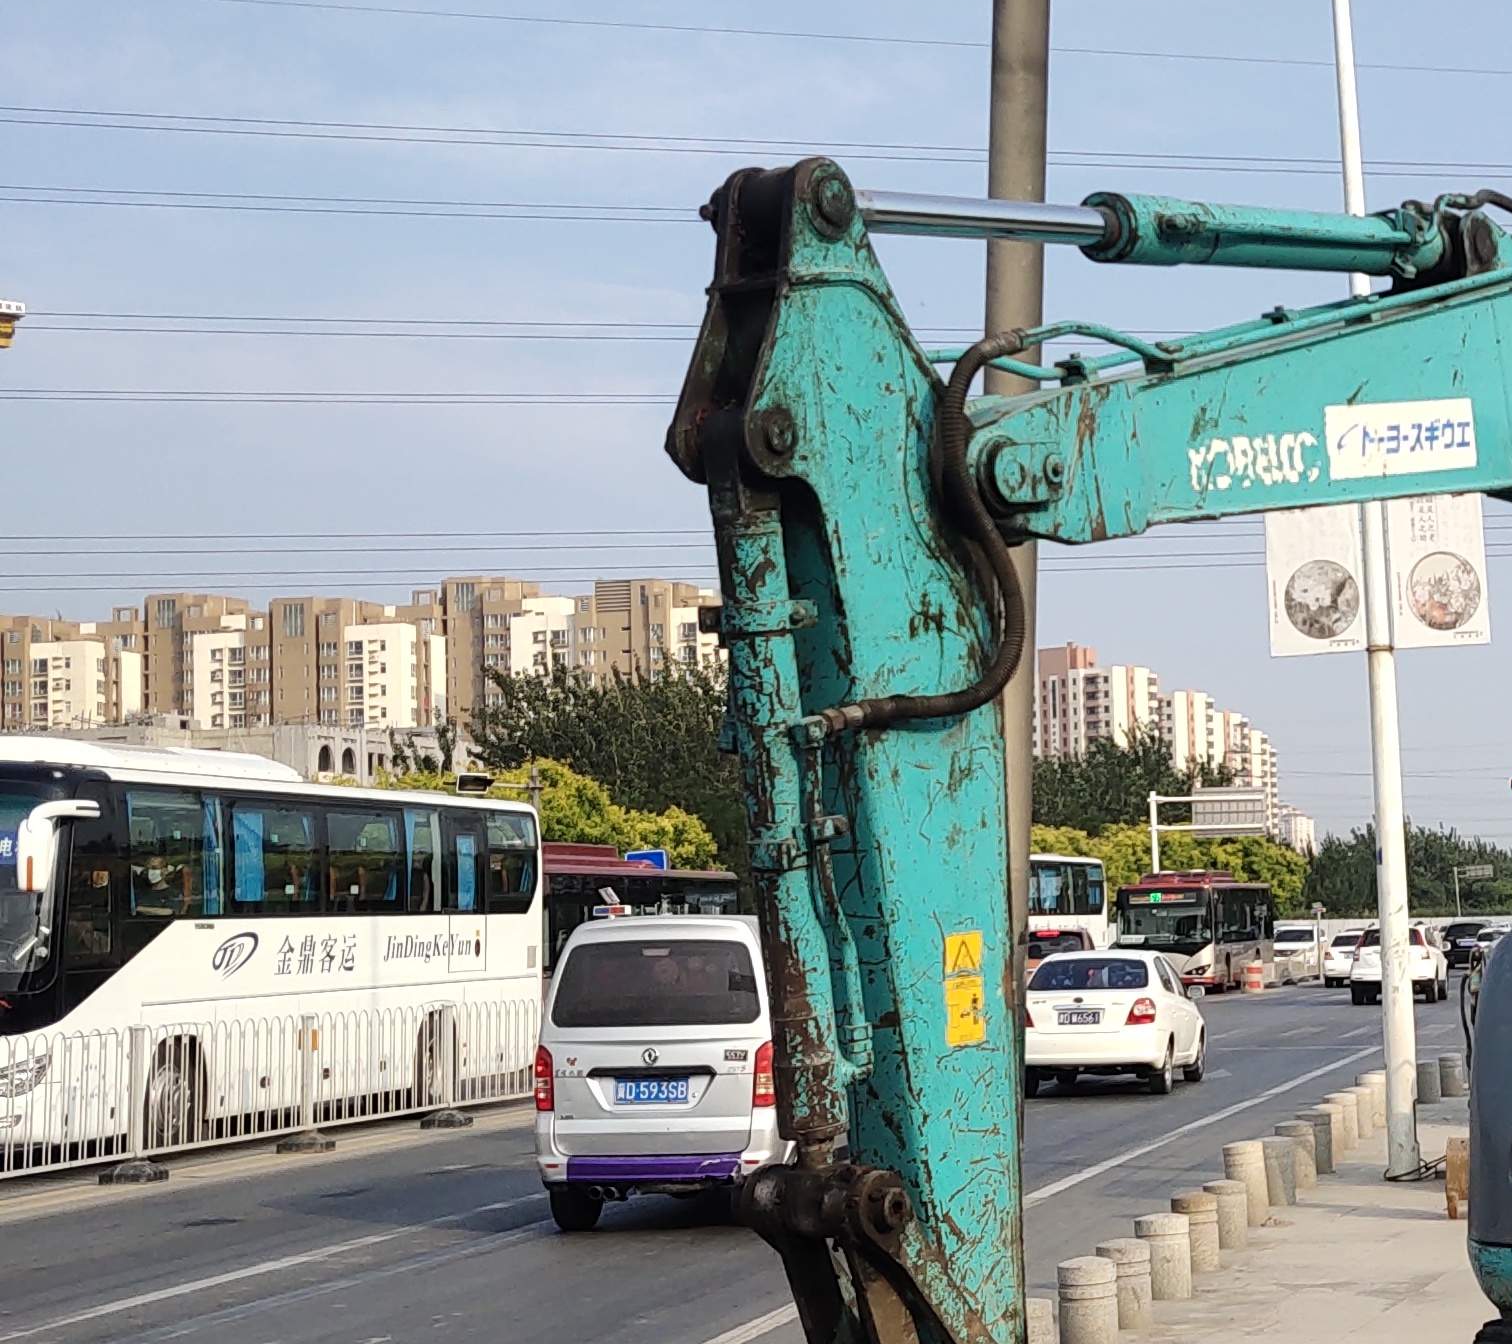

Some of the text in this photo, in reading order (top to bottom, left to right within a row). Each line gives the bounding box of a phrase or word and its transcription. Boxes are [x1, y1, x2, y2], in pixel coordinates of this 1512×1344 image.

[274, 934, 357, 976] 金鼎客运
[384, 933, 471, 964] JinDingKeYun
